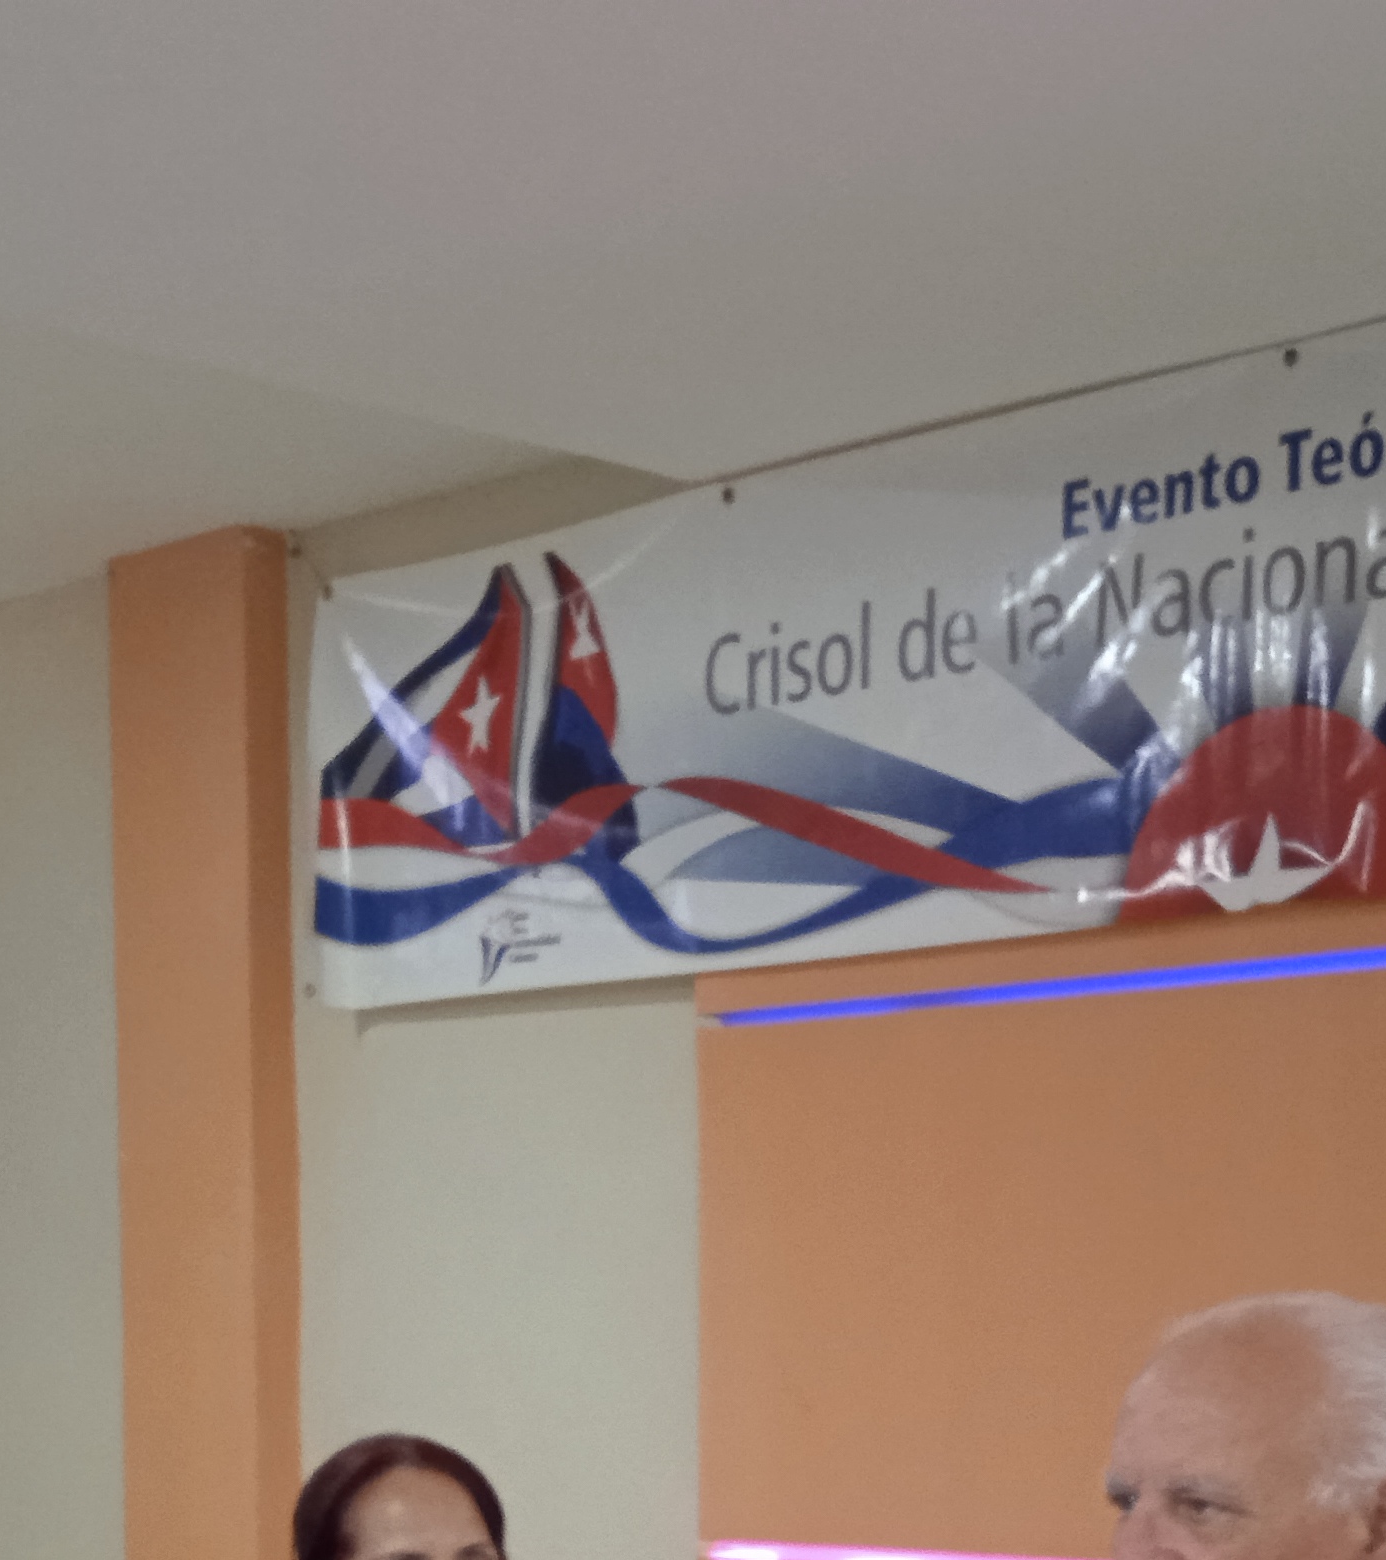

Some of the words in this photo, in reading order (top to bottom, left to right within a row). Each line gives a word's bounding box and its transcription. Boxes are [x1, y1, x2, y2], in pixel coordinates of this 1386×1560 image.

[1062, 451, 1259, 539] Evento
[705, 600, 871, 714] Crisol
[899, 587, 977, 681] de
[1006, 572, 1066, 664] la
